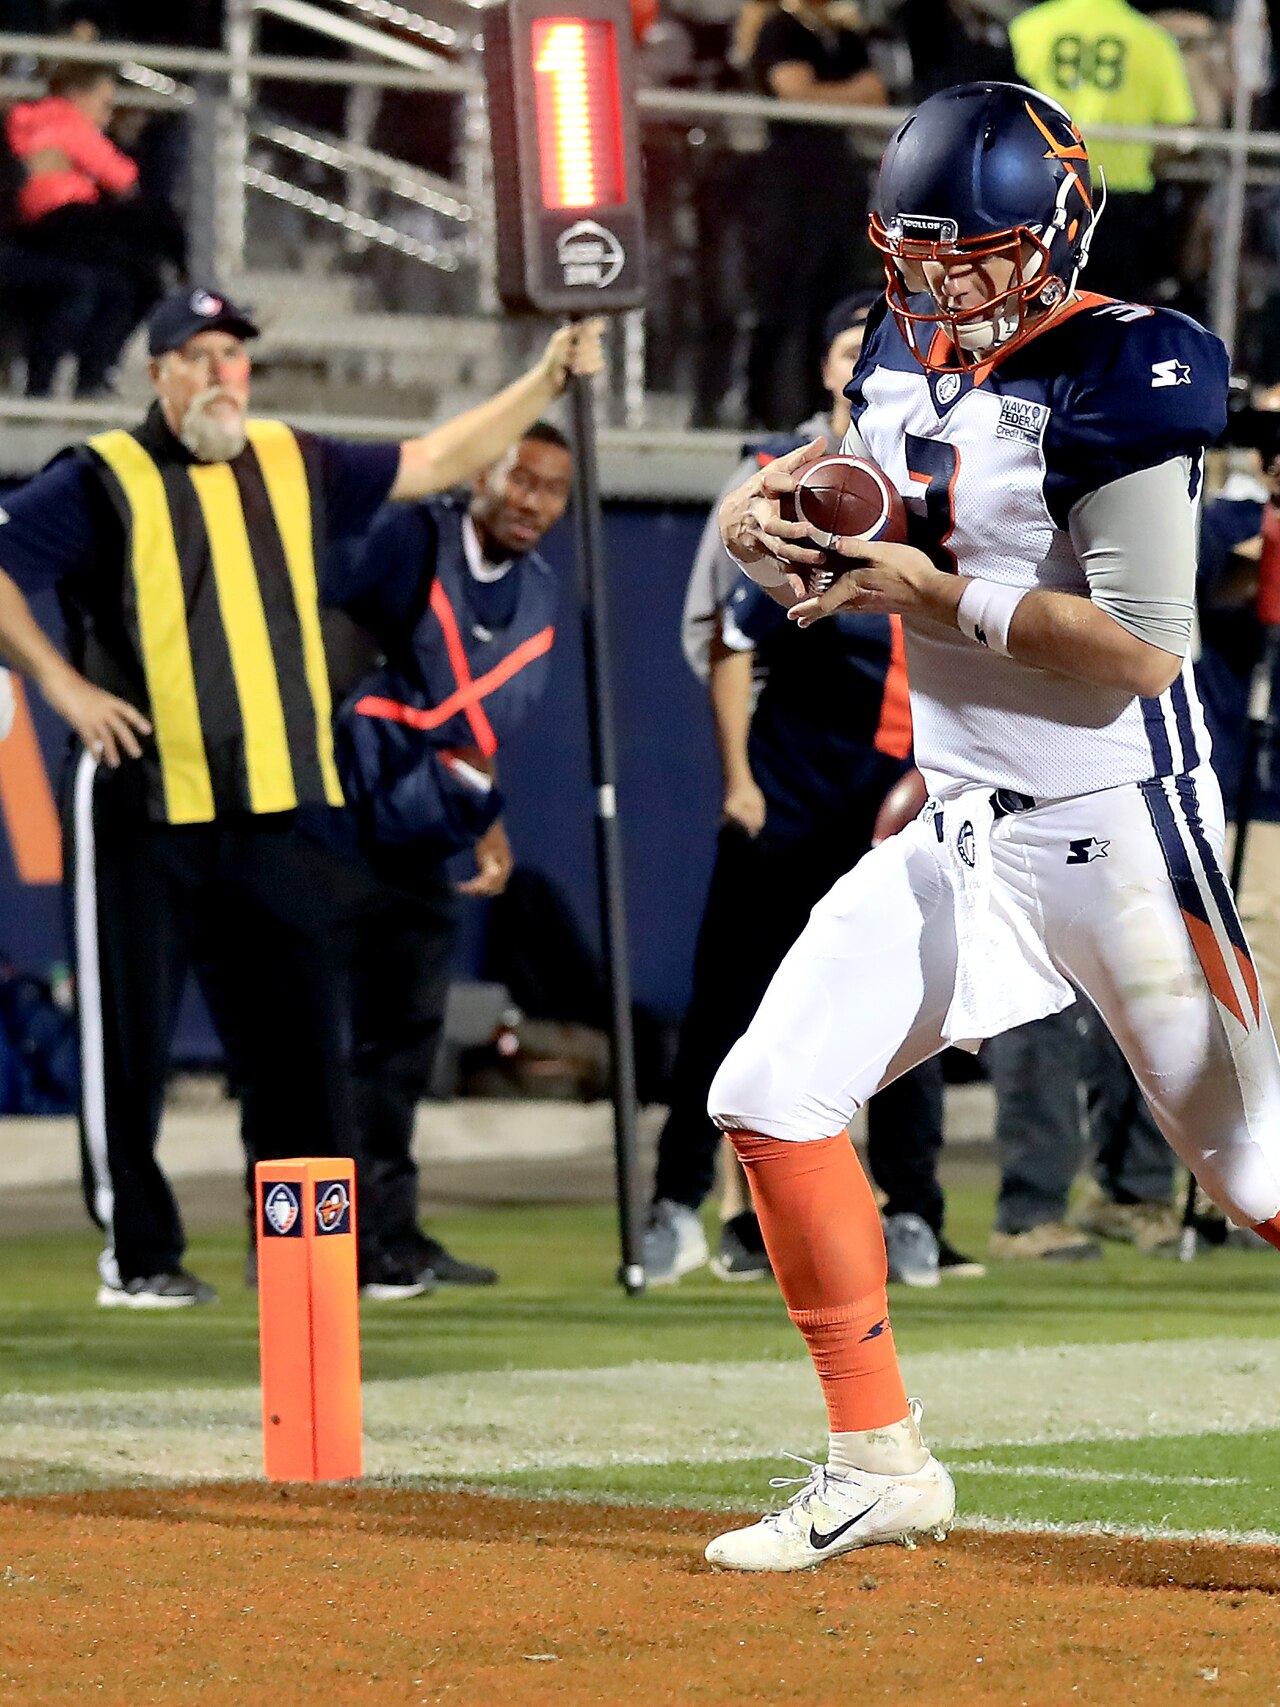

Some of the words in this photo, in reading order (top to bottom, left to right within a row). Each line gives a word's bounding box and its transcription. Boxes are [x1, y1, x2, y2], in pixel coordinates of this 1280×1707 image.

[1051, 34, 1126, 92] 88
[536, 23, 596, 207] 1
[1002, 399, 1032, 415] NAVY
[999, 409, 1042, 431] FEDERAL
[996, 425, 1019, 438] Credit
